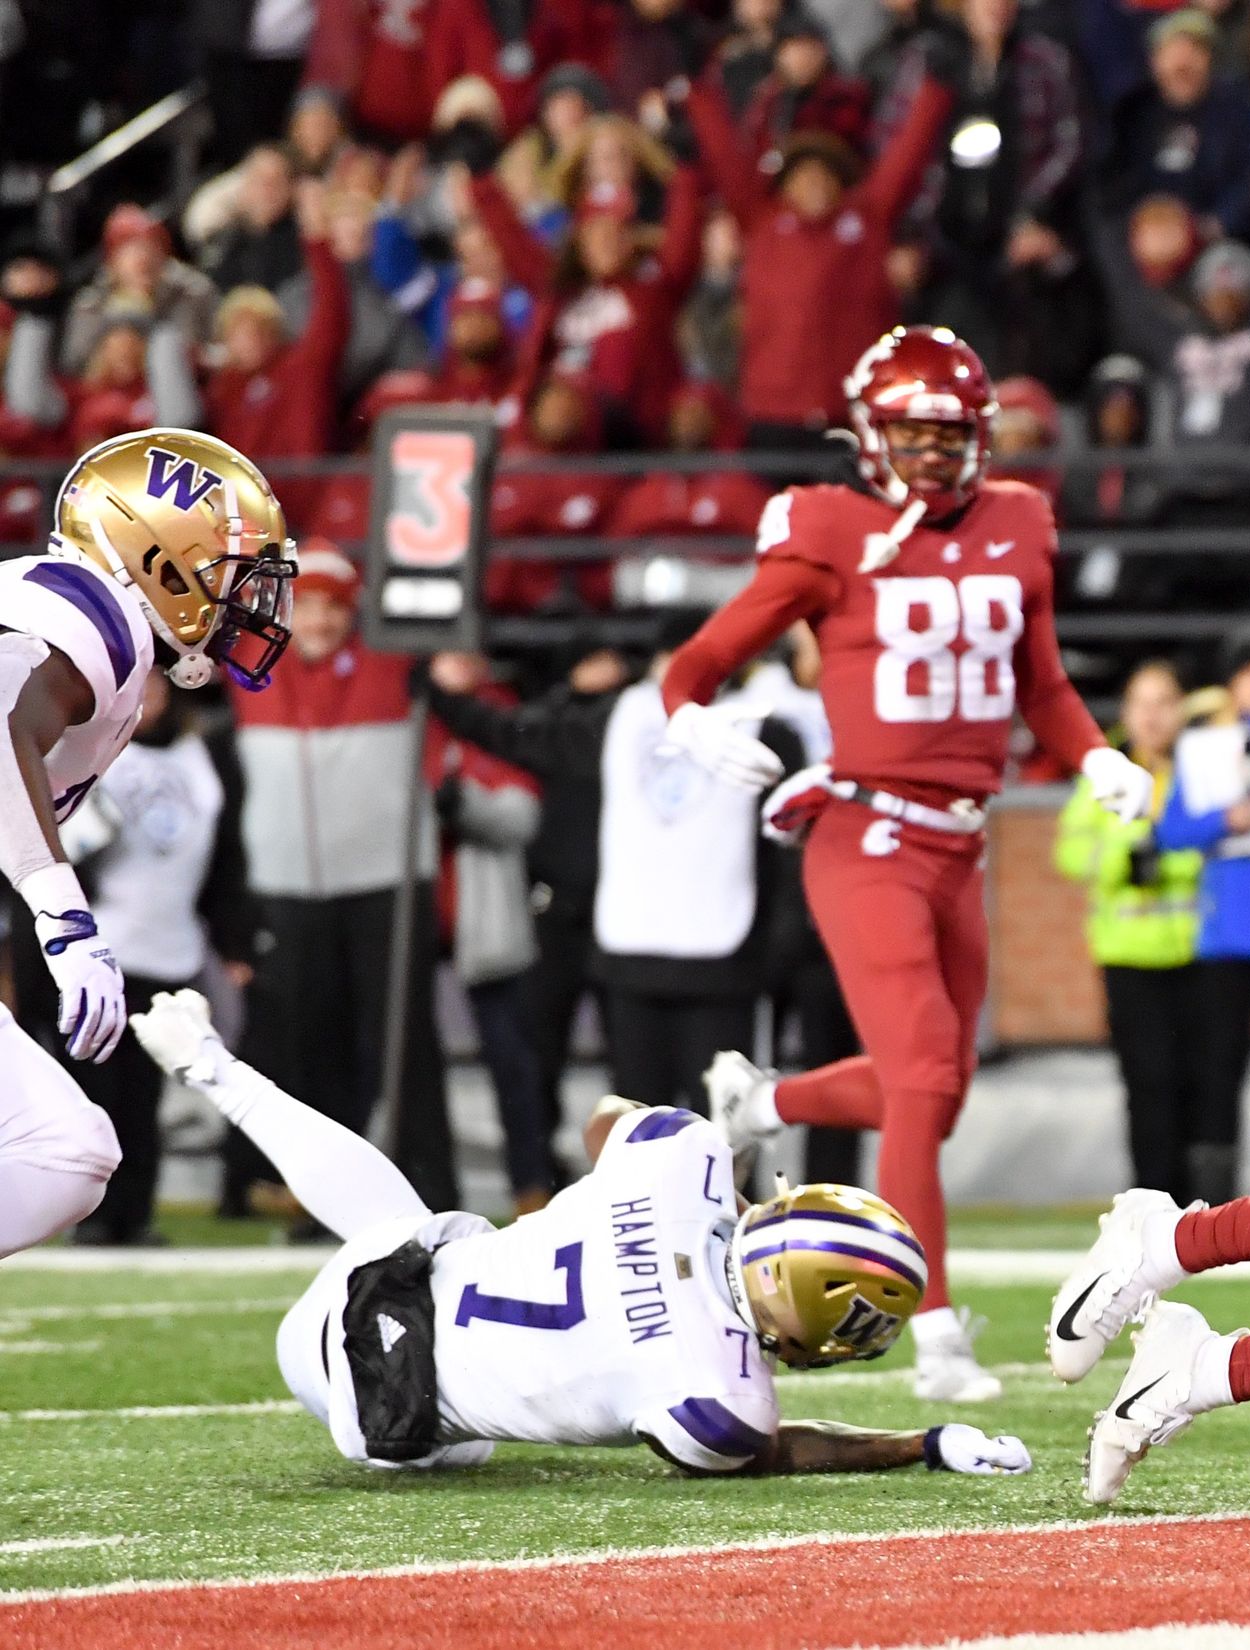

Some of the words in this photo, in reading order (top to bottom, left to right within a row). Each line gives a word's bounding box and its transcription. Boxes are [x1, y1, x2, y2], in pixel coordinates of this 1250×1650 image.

[145, 446, 223, 513] W
[386, 431, 475, 567] 3
[872, 573, 1025, 723] 88
[703, 1153, 723, 1206] 7
[454, 1240, 587, 1331] 7
[611, 1196, 673, 1344] HAMPTON
[724, 1326, 752, 1379] 7
[831, 1292, 903, 1350] W
